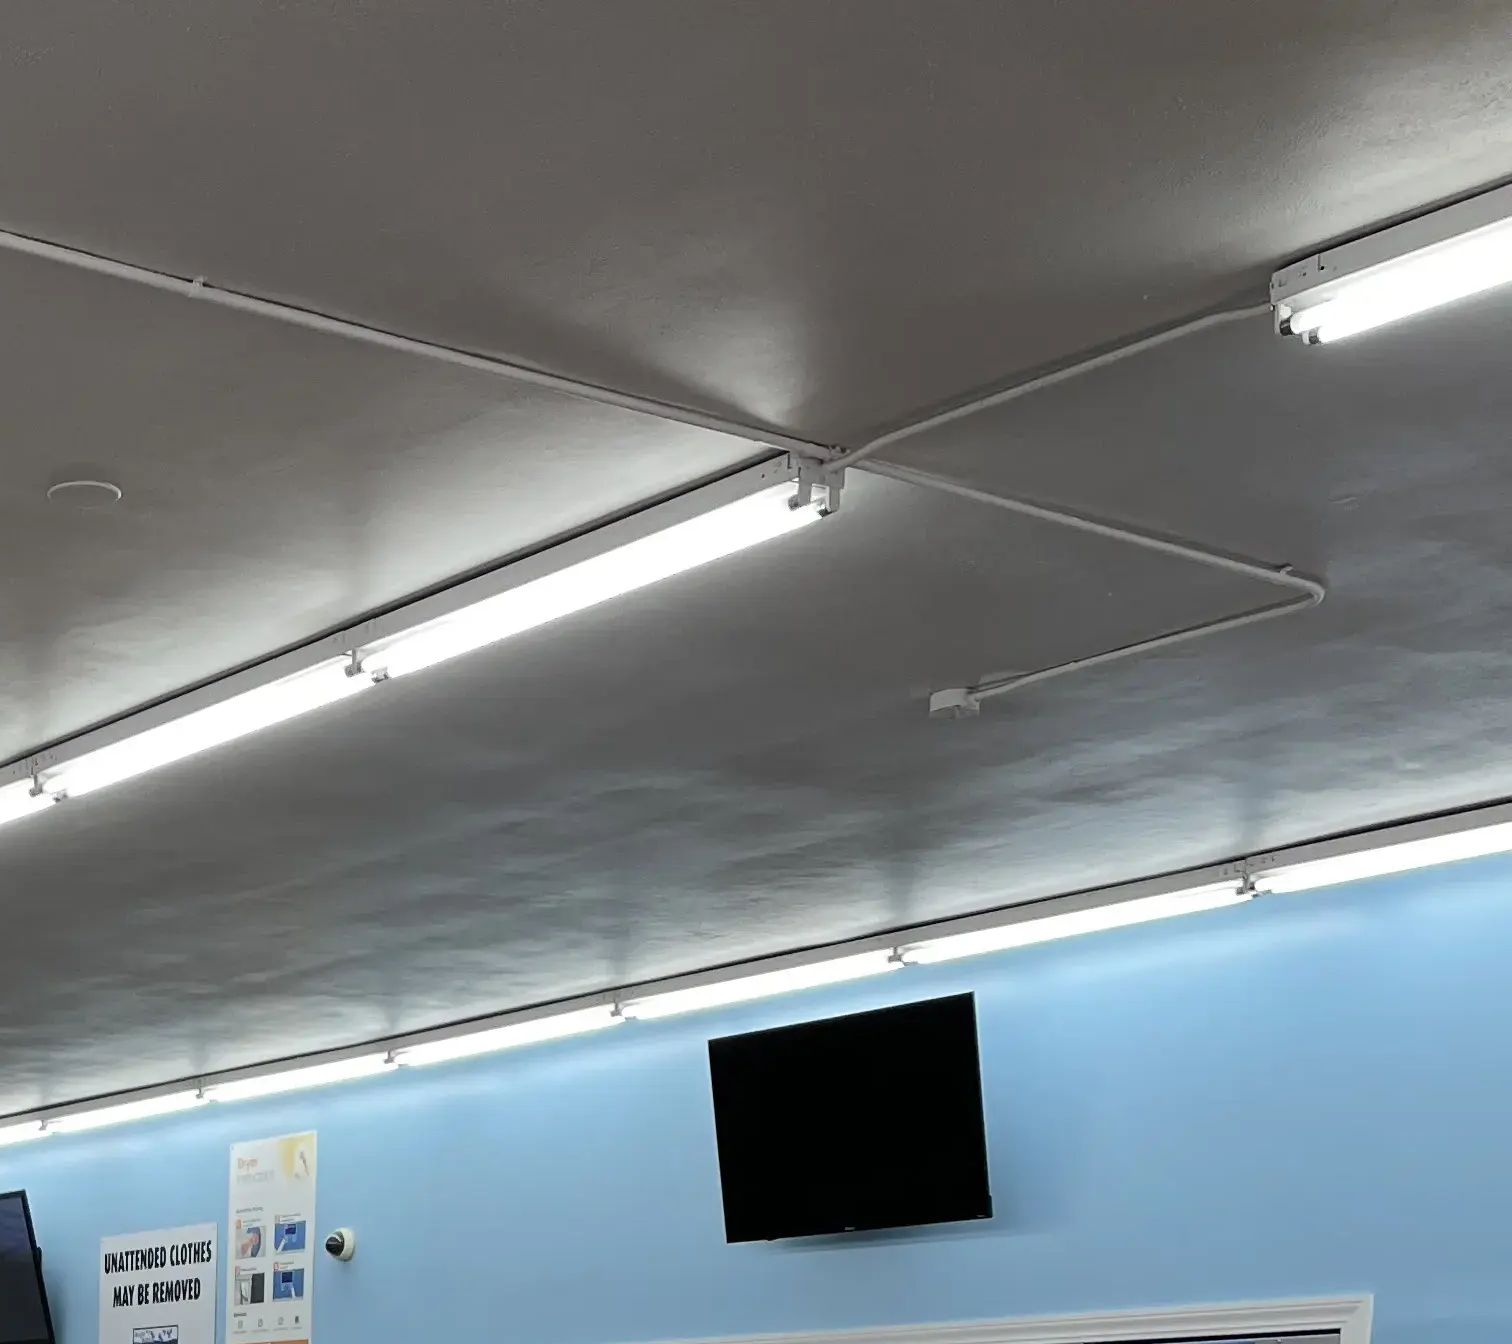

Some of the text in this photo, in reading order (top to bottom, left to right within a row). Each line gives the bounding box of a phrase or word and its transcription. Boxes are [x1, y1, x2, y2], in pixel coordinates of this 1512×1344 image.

[105, 1240, 212, 1274] UNATTENDED CLOTHES
[113, 1278, 201, 1307] MAY BE REMOVED
